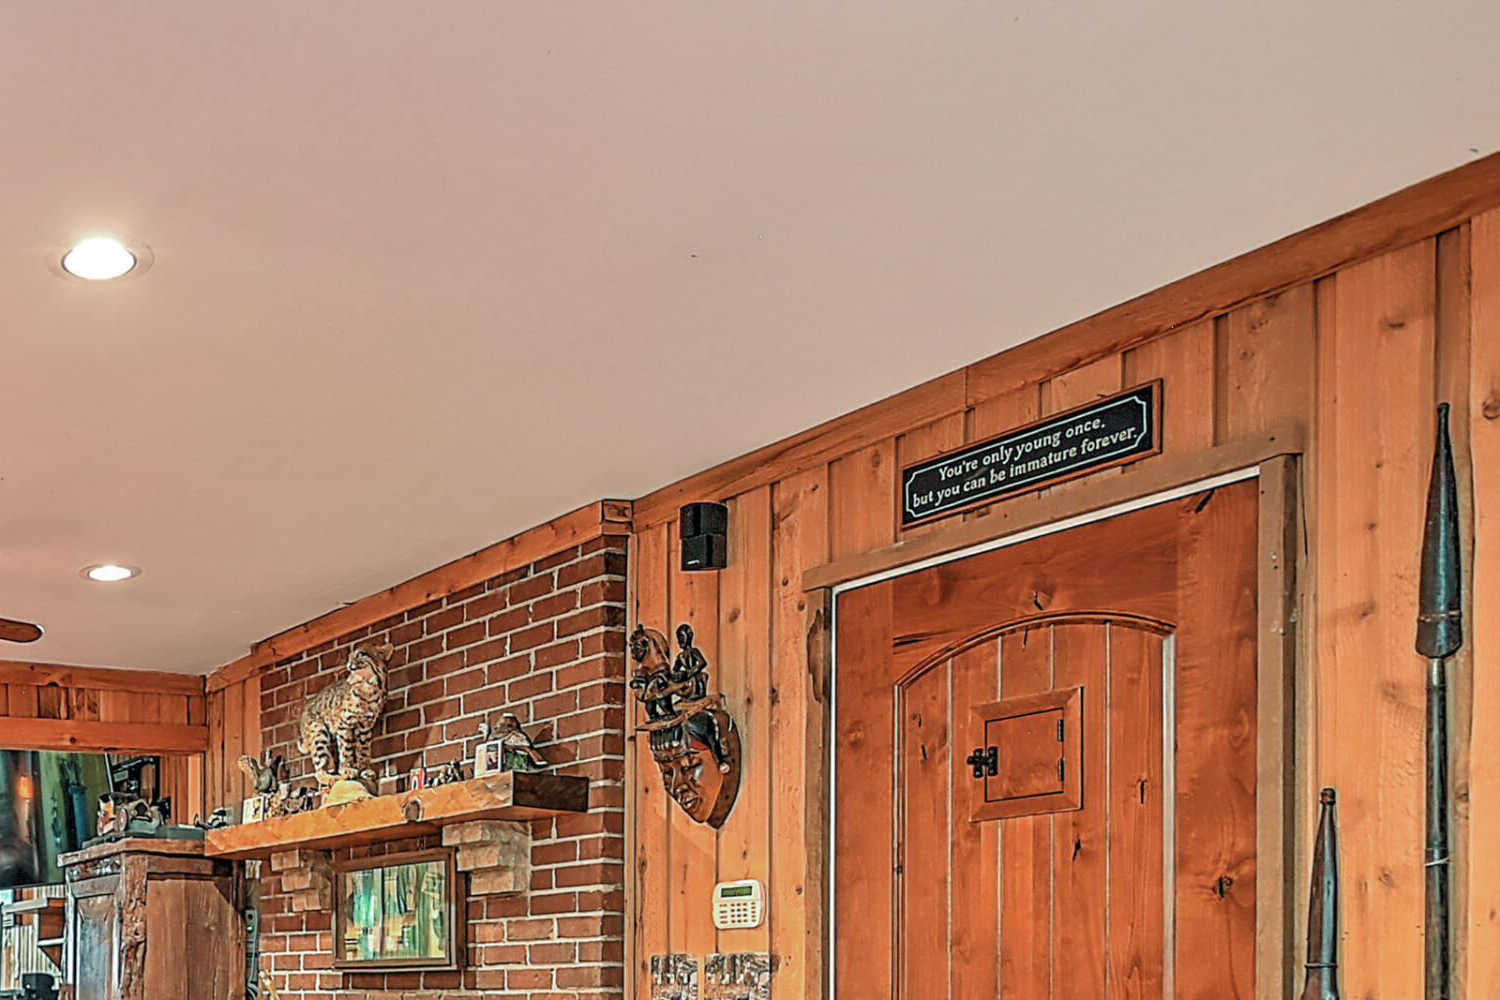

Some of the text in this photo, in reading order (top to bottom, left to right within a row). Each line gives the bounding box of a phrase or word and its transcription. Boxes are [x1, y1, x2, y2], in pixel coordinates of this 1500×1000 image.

[912, 426, 1139, 509] but you can be immature forever.
[938, 418, 1106, 481] You're only young once.
